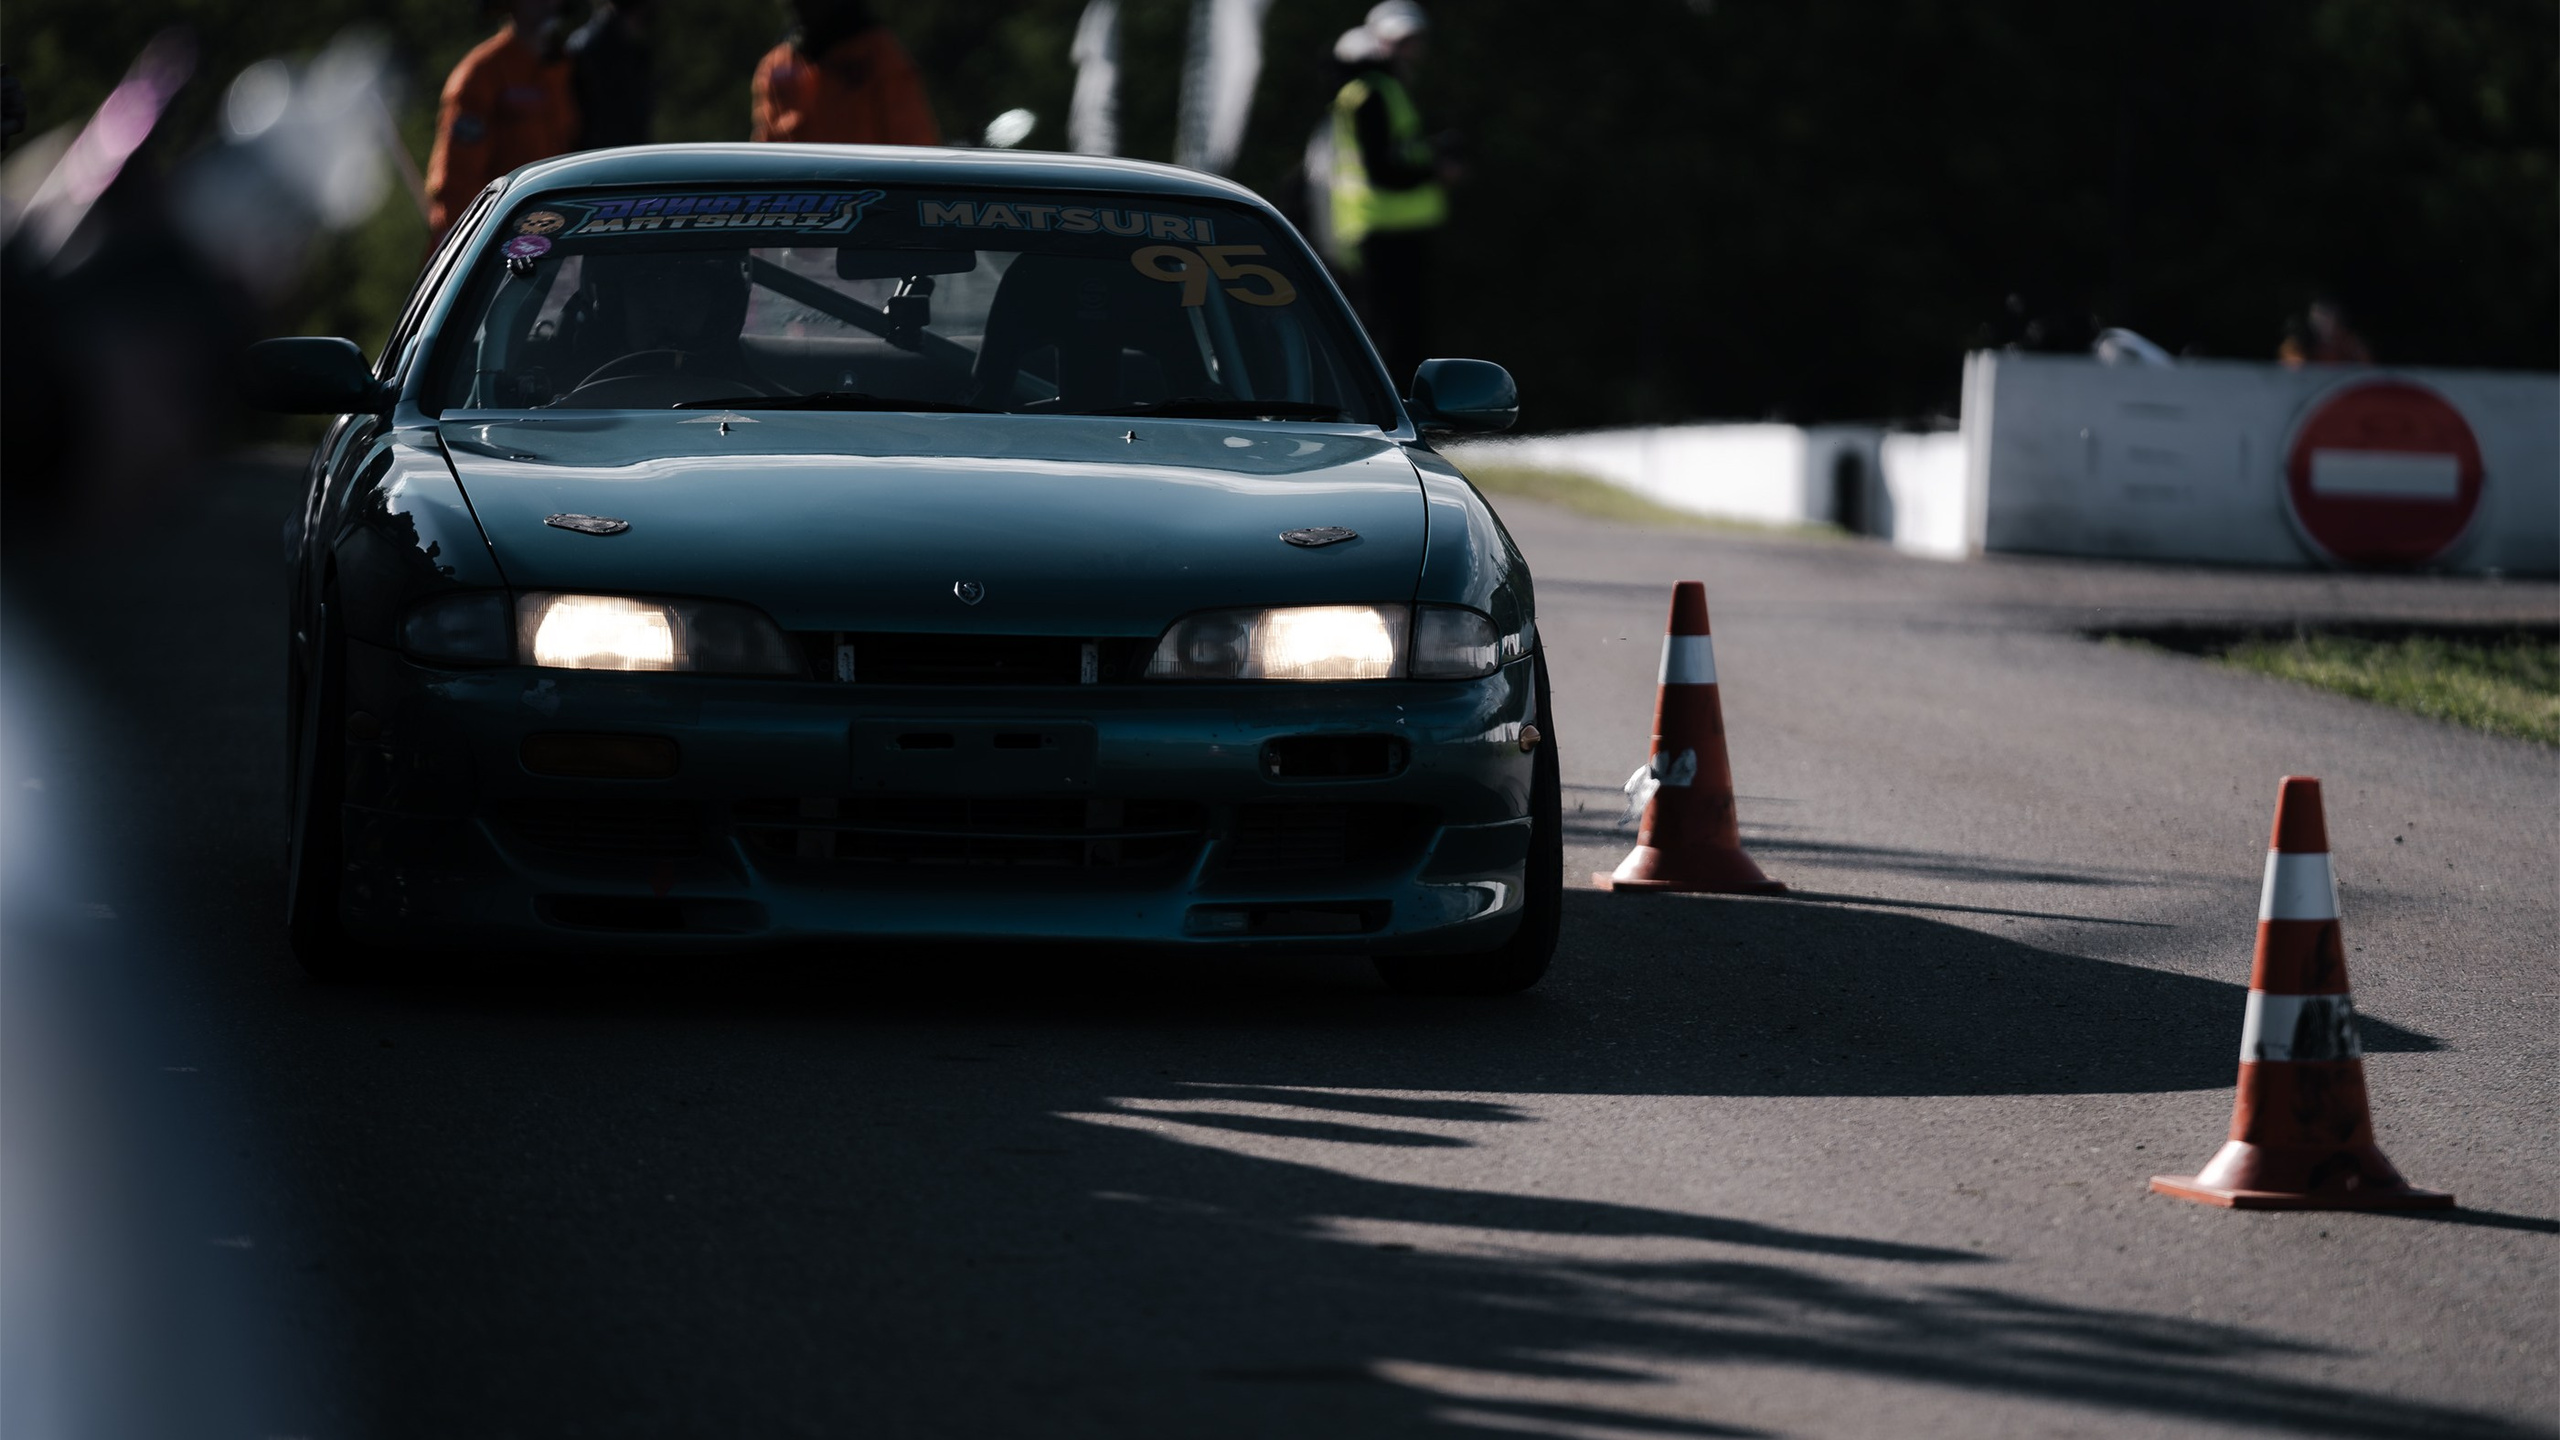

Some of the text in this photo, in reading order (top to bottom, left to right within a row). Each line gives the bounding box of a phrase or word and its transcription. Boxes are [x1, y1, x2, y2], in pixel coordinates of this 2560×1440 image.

[577, 212, 831, 234] MATSURI
[918, 200, 1215, 244] MATSURI
[1131, 245, 1297, 307] 95
